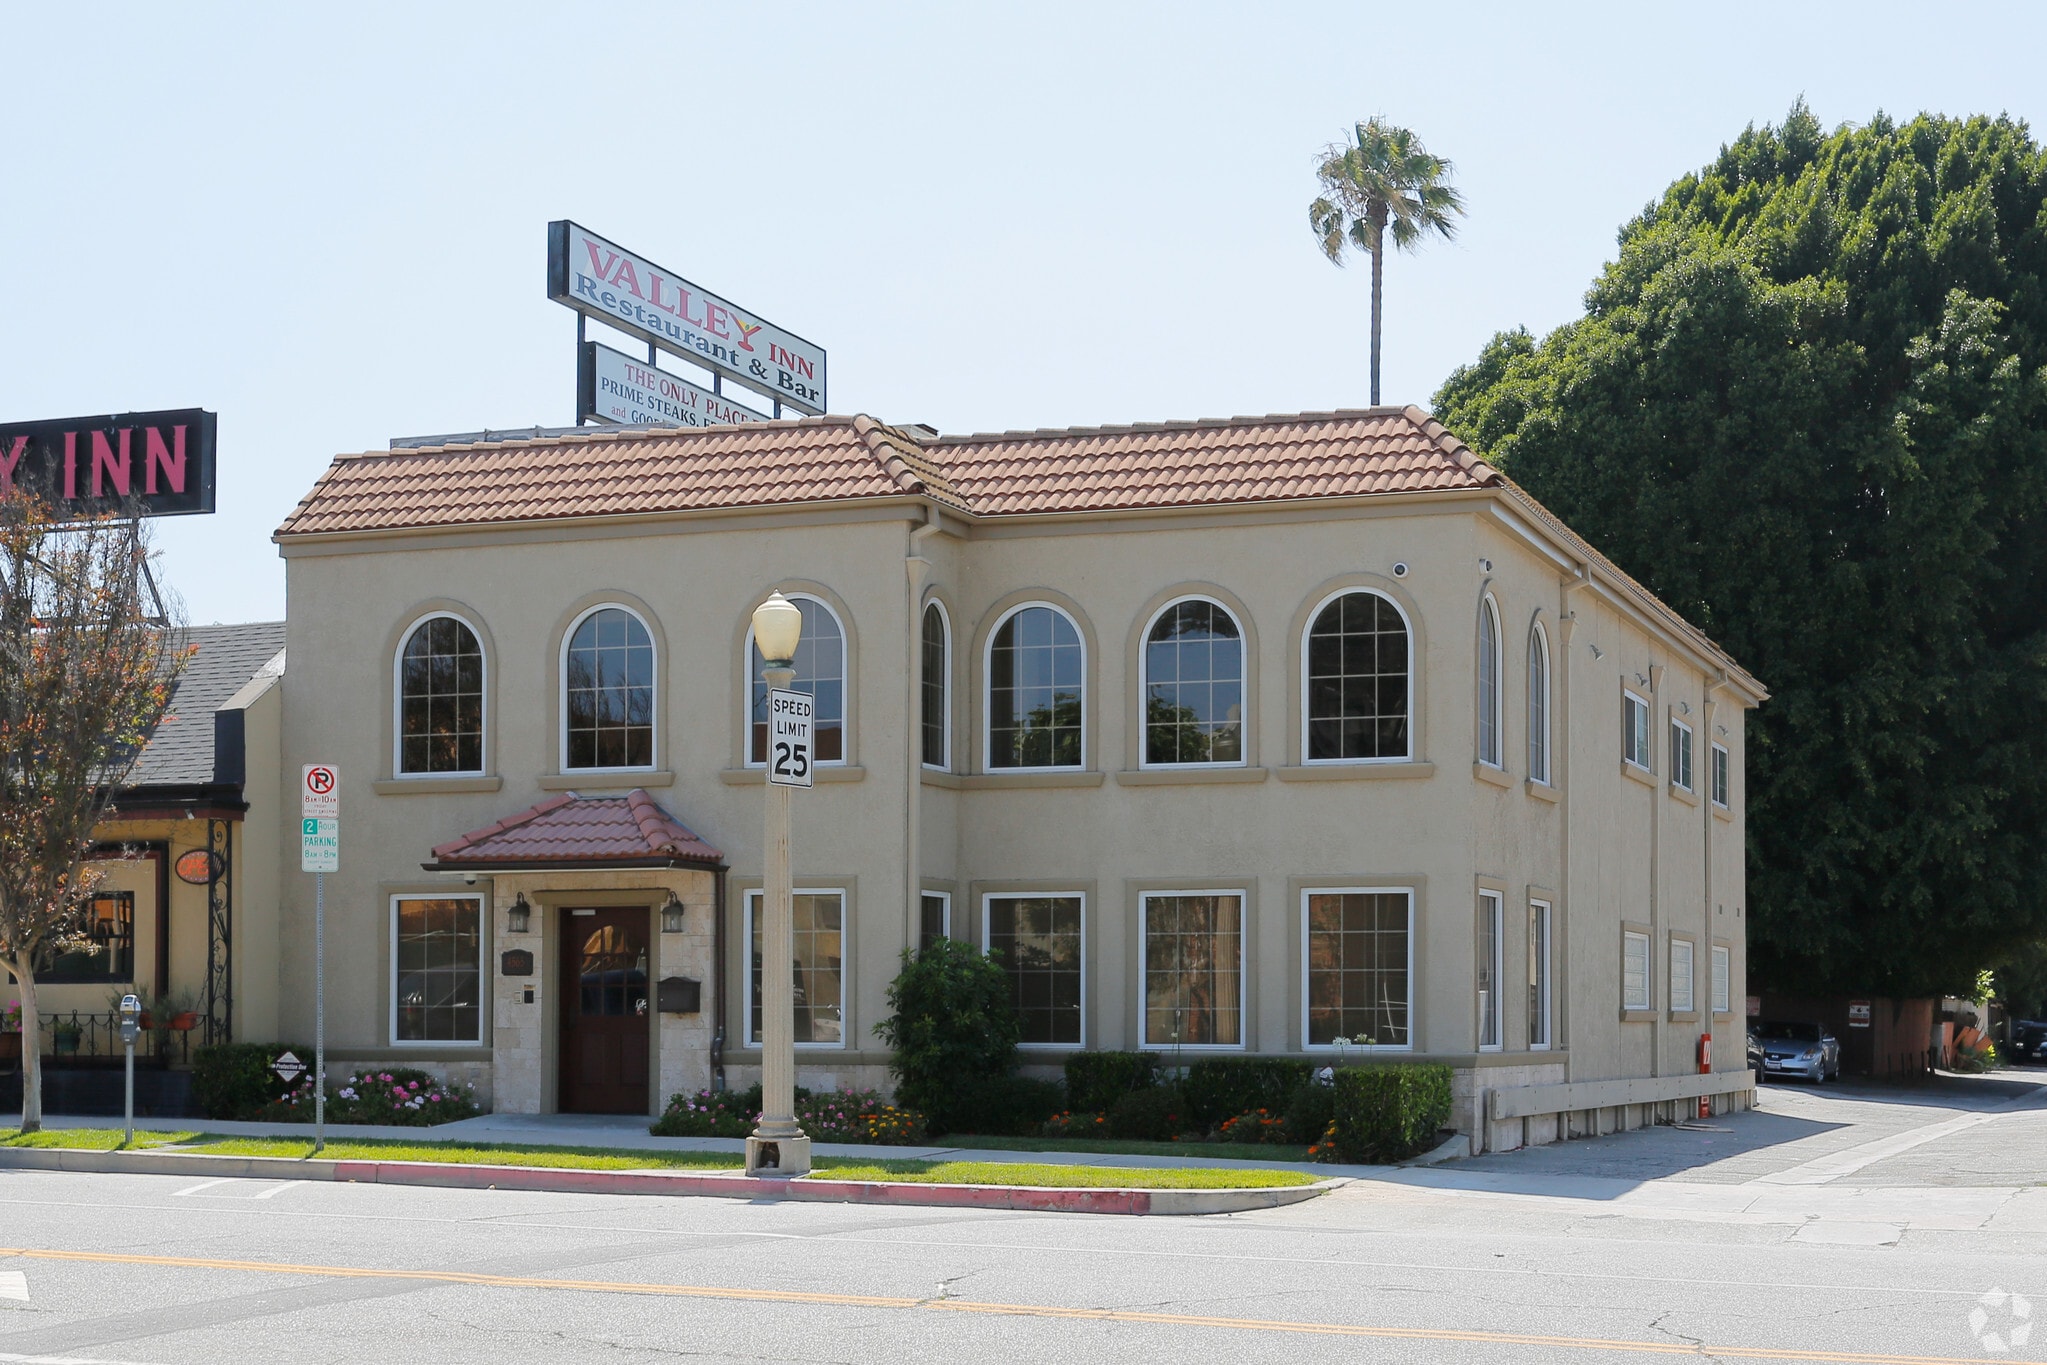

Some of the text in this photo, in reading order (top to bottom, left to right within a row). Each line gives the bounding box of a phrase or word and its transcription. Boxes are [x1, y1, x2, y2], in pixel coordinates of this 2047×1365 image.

[582, 238, 814, 380] VALLEY INN
[575, 272, 820, 402] Restaurant & Bar
[601, 377, 643, 405] PRIME
[625, 363, 656, 391] THE
[659, 379, 698, 409] ONLY
[611, 406, 626, 419] and
[63, 424, 188, 499] INN
[774, 698, 811, 717] SPEED
[777, 720, 807, 737] LIMIT
[775, 742, 808, 777] 25
[306, 821, 314, 833] 2
[304, 836, 337, 847] PARKING
[177, 857, 210, 876] OPE
